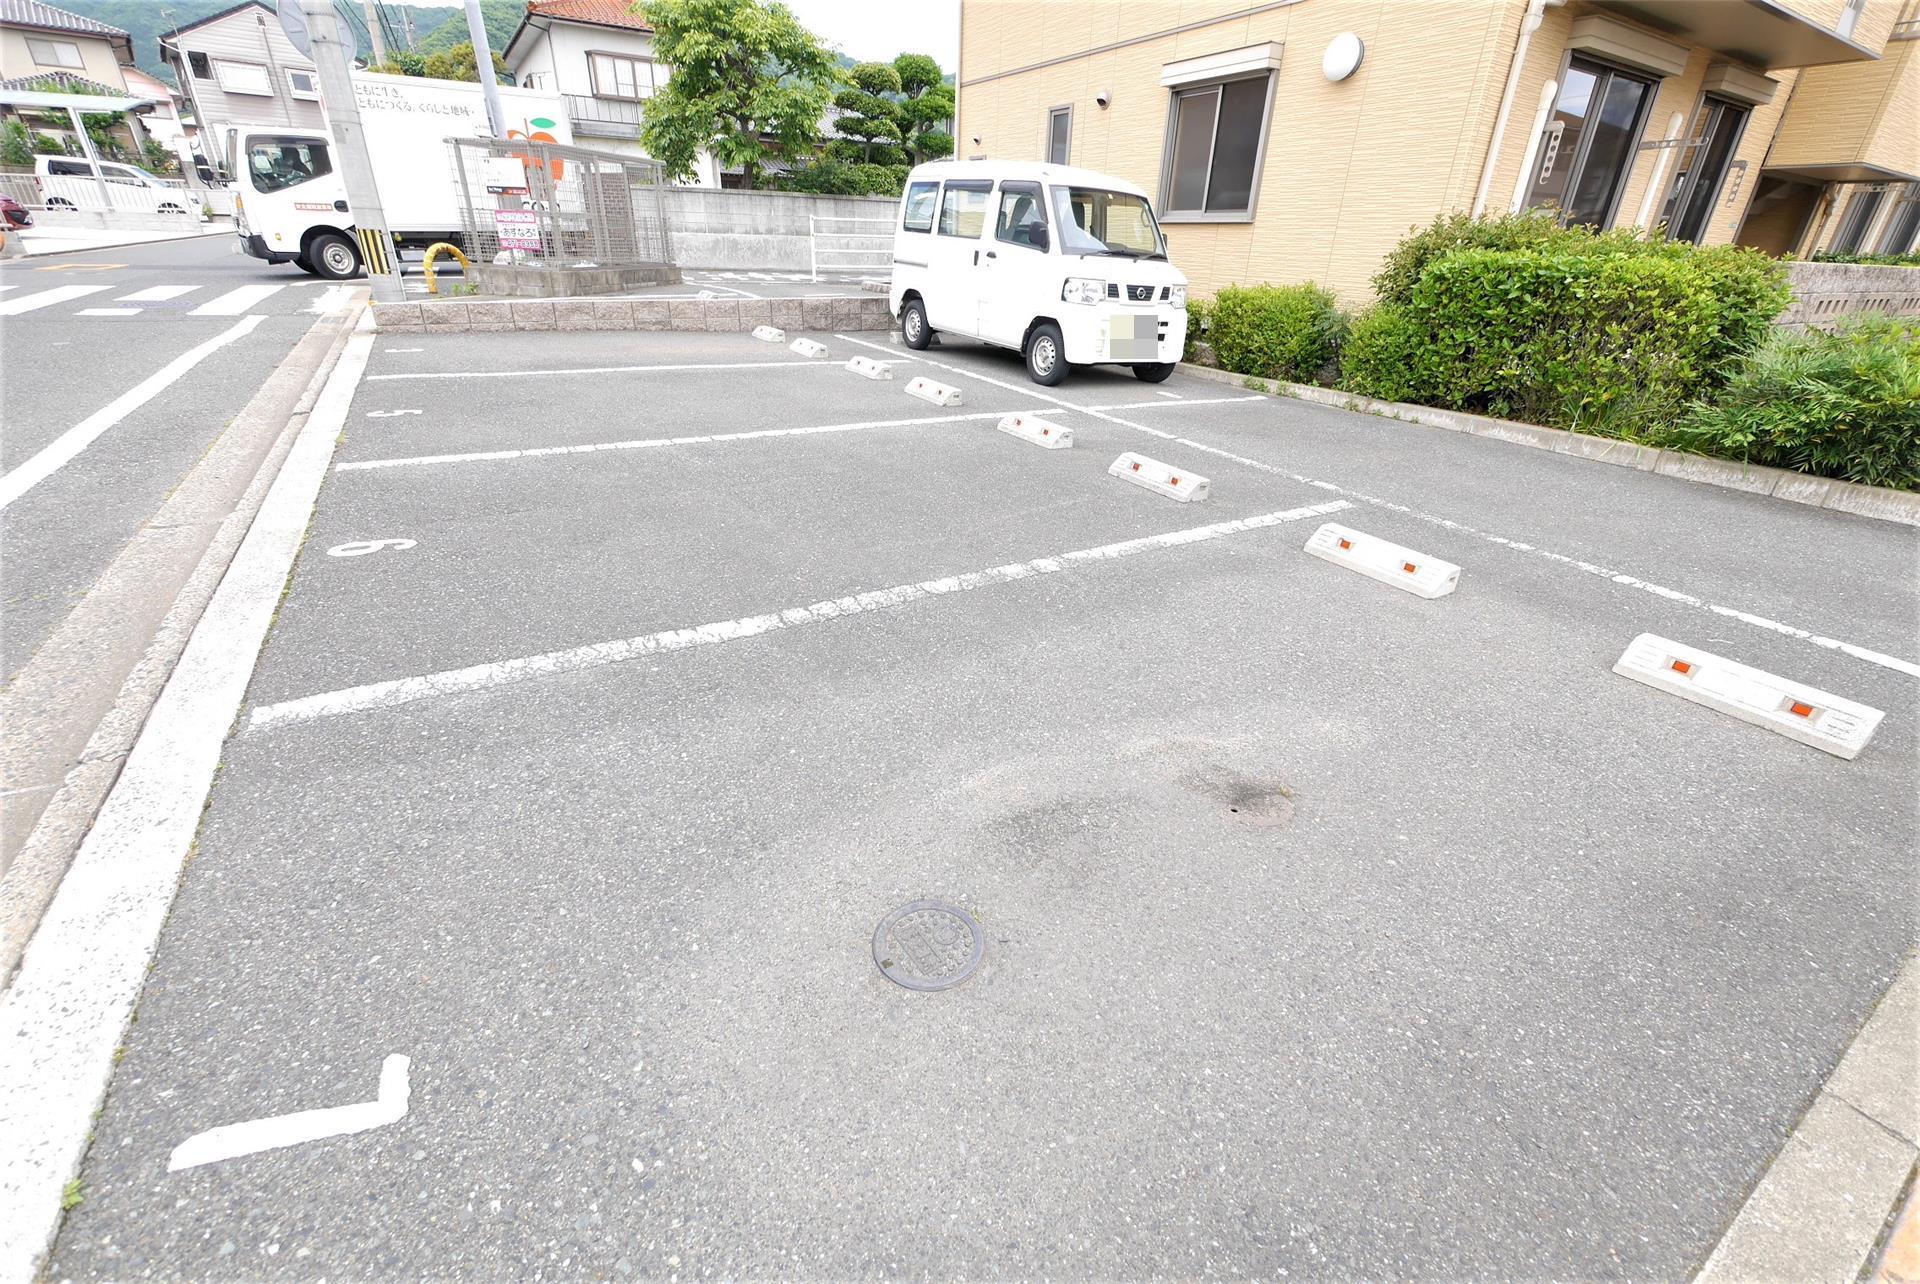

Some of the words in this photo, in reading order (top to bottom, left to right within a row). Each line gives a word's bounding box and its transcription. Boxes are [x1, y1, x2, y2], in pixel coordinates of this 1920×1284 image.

[366, 409, 424, 418] 5
[326, 538, 418, 557] 6
[167, 1053, 412, 1173] 7
